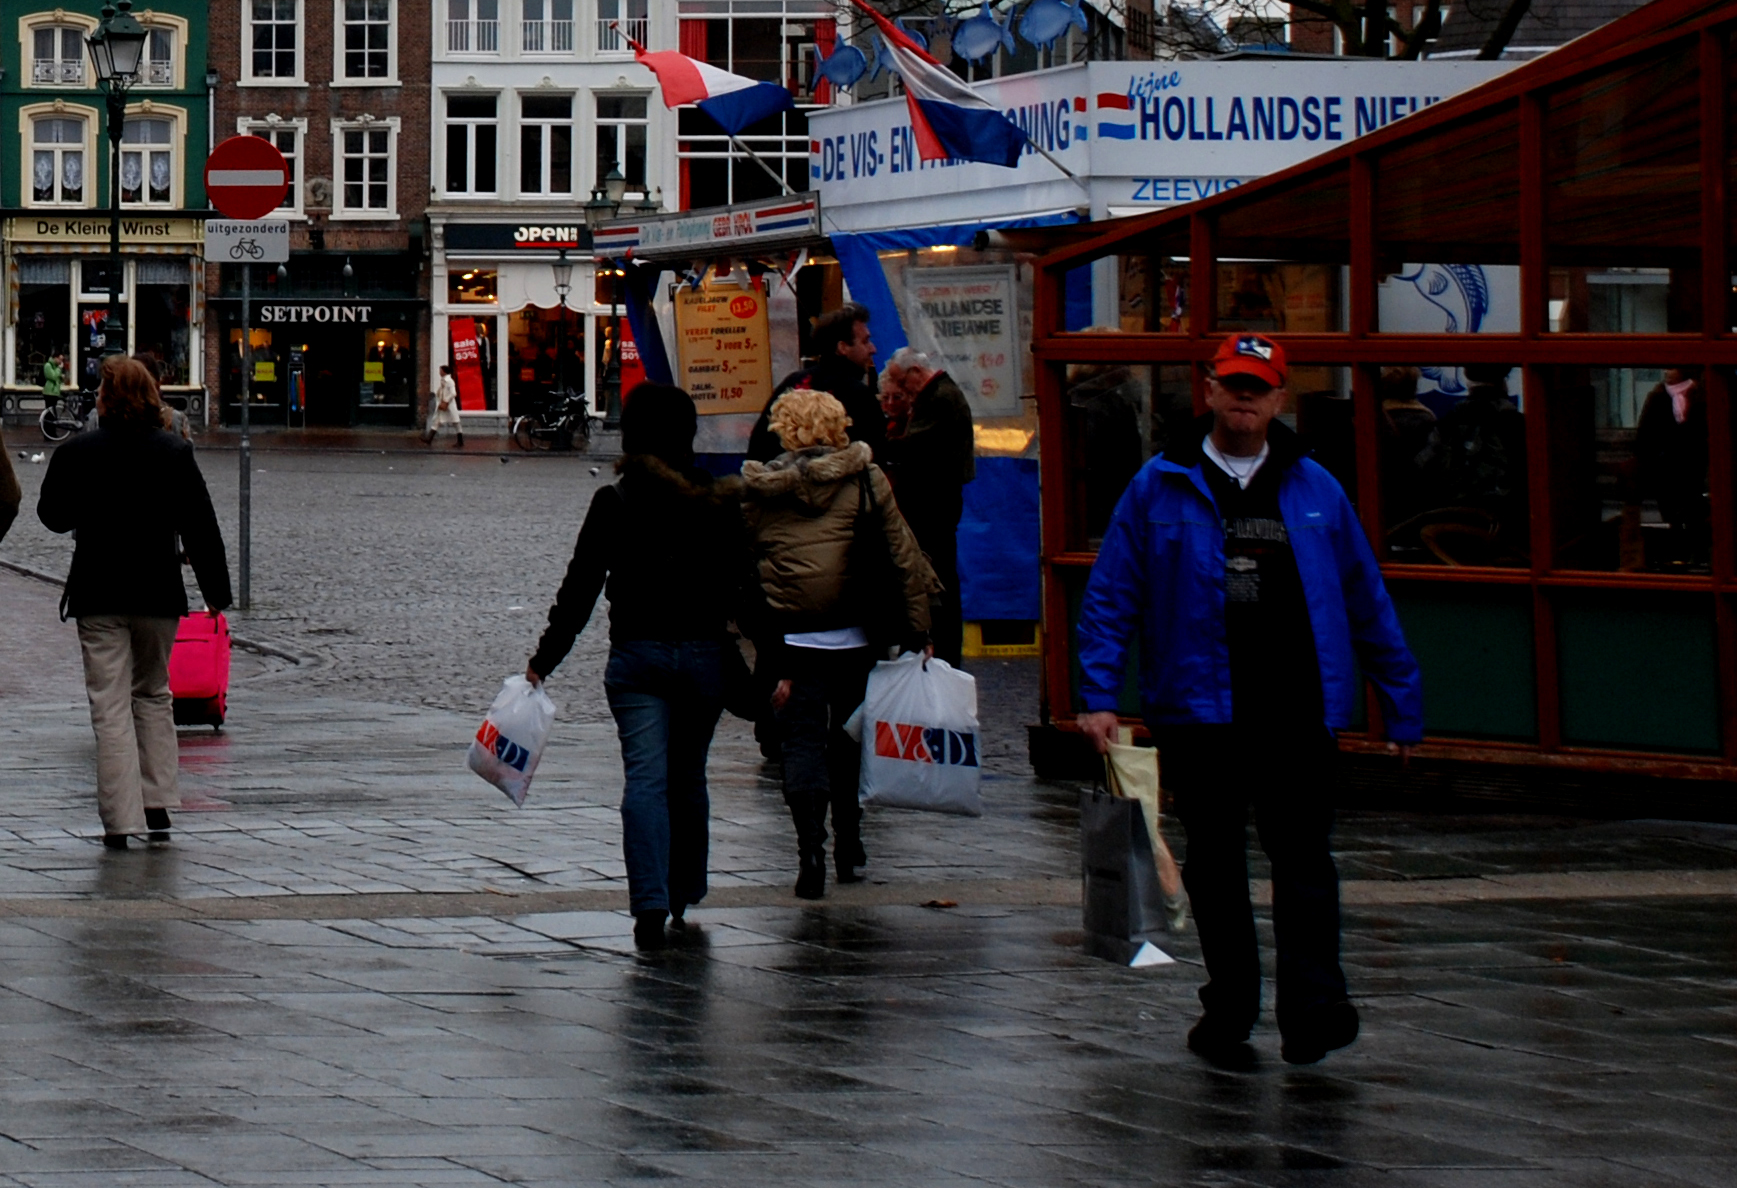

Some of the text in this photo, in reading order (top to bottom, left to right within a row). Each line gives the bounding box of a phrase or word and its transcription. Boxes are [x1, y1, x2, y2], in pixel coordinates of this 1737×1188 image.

[1139, 96, 1342, 141] HOLLANDSE
[822, 136, 845, 182] DE
[850, 130, 884, 179] VIS-
[890, 125, 913, 174] EN
[36, 221, 59, 235] De
[122, 221, 170, 235] Winst
[207, 223, 287, 236] uitgezonderd
[260, 305, 372, 323] SETPOINT
[685, 326, 746, 335] VERSE FORELLEN
[933, 320, 1001, 338] NIEUWE
[453, 338, 476, 349] sale
[724, 341, 742, 350] VOOR
[455, 350, 478, 360] 50%
[688, 365, 720, 373] GAMBAS
[483, 720, 521, 765] V&D
[887, 720, 967, 765] V&D
